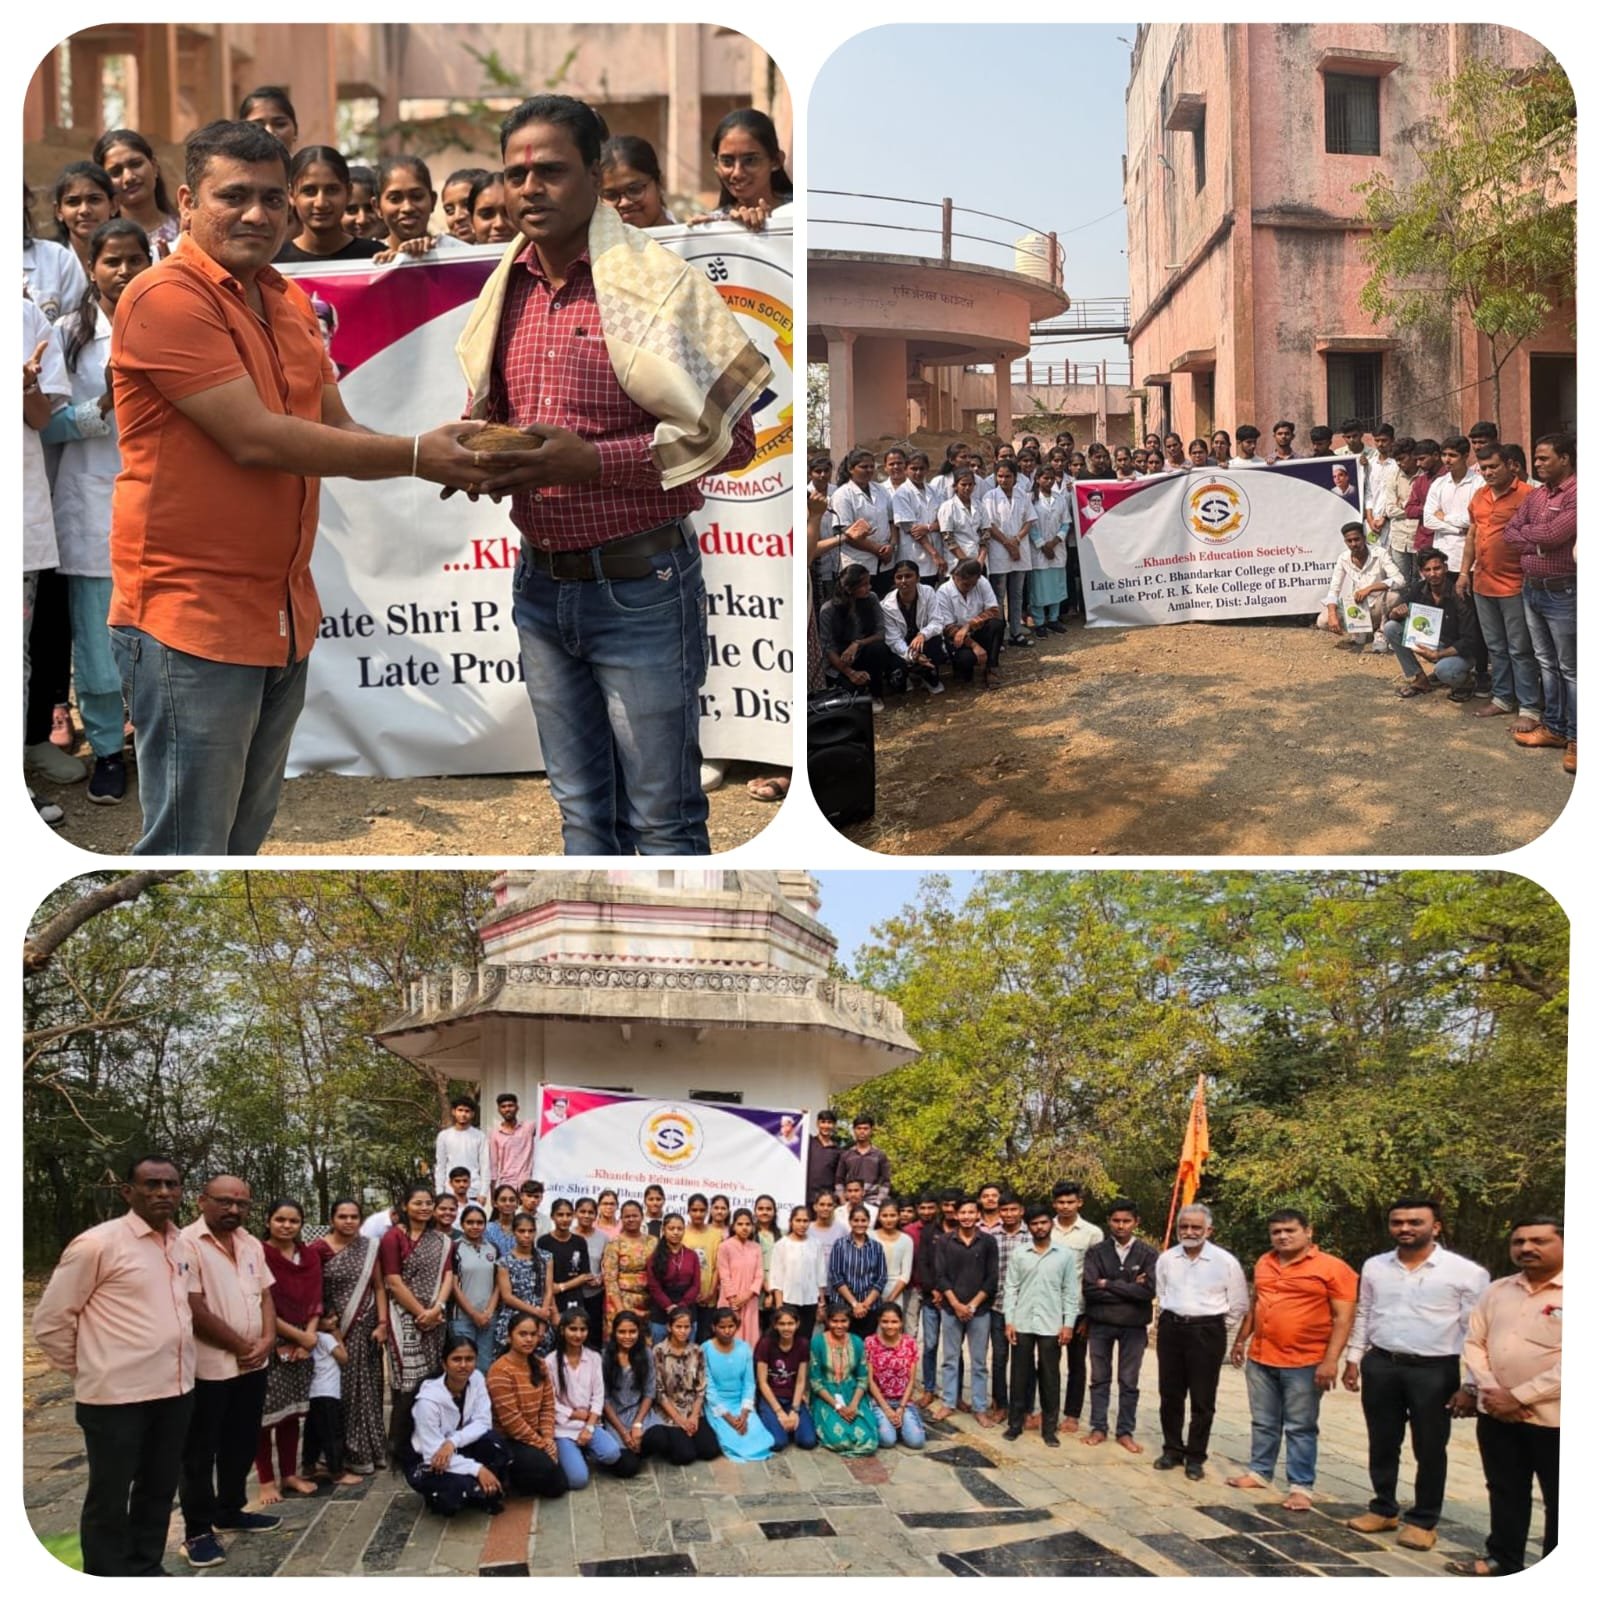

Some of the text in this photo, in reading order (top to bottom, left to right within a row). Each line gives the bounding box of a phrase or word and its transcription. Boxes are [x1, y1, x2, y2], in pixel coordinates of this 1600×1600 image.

[721, 294, 755, 310] ATON
[699, 522, 793, 557] ducat
[1134, 545, 1313, 569] ...Khandesh Education Society's...
[1091, 580, 1115, 591] Late
[1118, 576, 1141, 589] Shri
[1144, 575, 1153, 586] P.
[1155, 574, 1167, 584] C.
[1169, 569, 1232, 582] Bhandarkar
[1235, 565, 1275, 577] College
[1278, 563, 1290, 573] of
[1110, 594, 1135, 605] Late
[1138, 589, 1164, 601] Prof.
[1167, 587, 1179, 598] R.
[1182, 585, 1193, 595] K.
[1196, 583, 1219, 594] Kele
[1222, 581, 1262, 592] College
[1265, 579, 1276, 589] of
[1167, 594, 1287, 612] Amalner, Dist: Jalgaon
[316, 607, 375, 638] ate
[387, 601, 461, 635] Shri
[472, 601, 500, 632] P.
[707, 584, 784, 619] rkar
[358, 654, 439, 688] Late
[708, 635, 741, 667] le
[732, 687, 793, 724] Dis
[567, 1183, 589, 1195] Shri
[649, 1174, 700, 1187] Education
